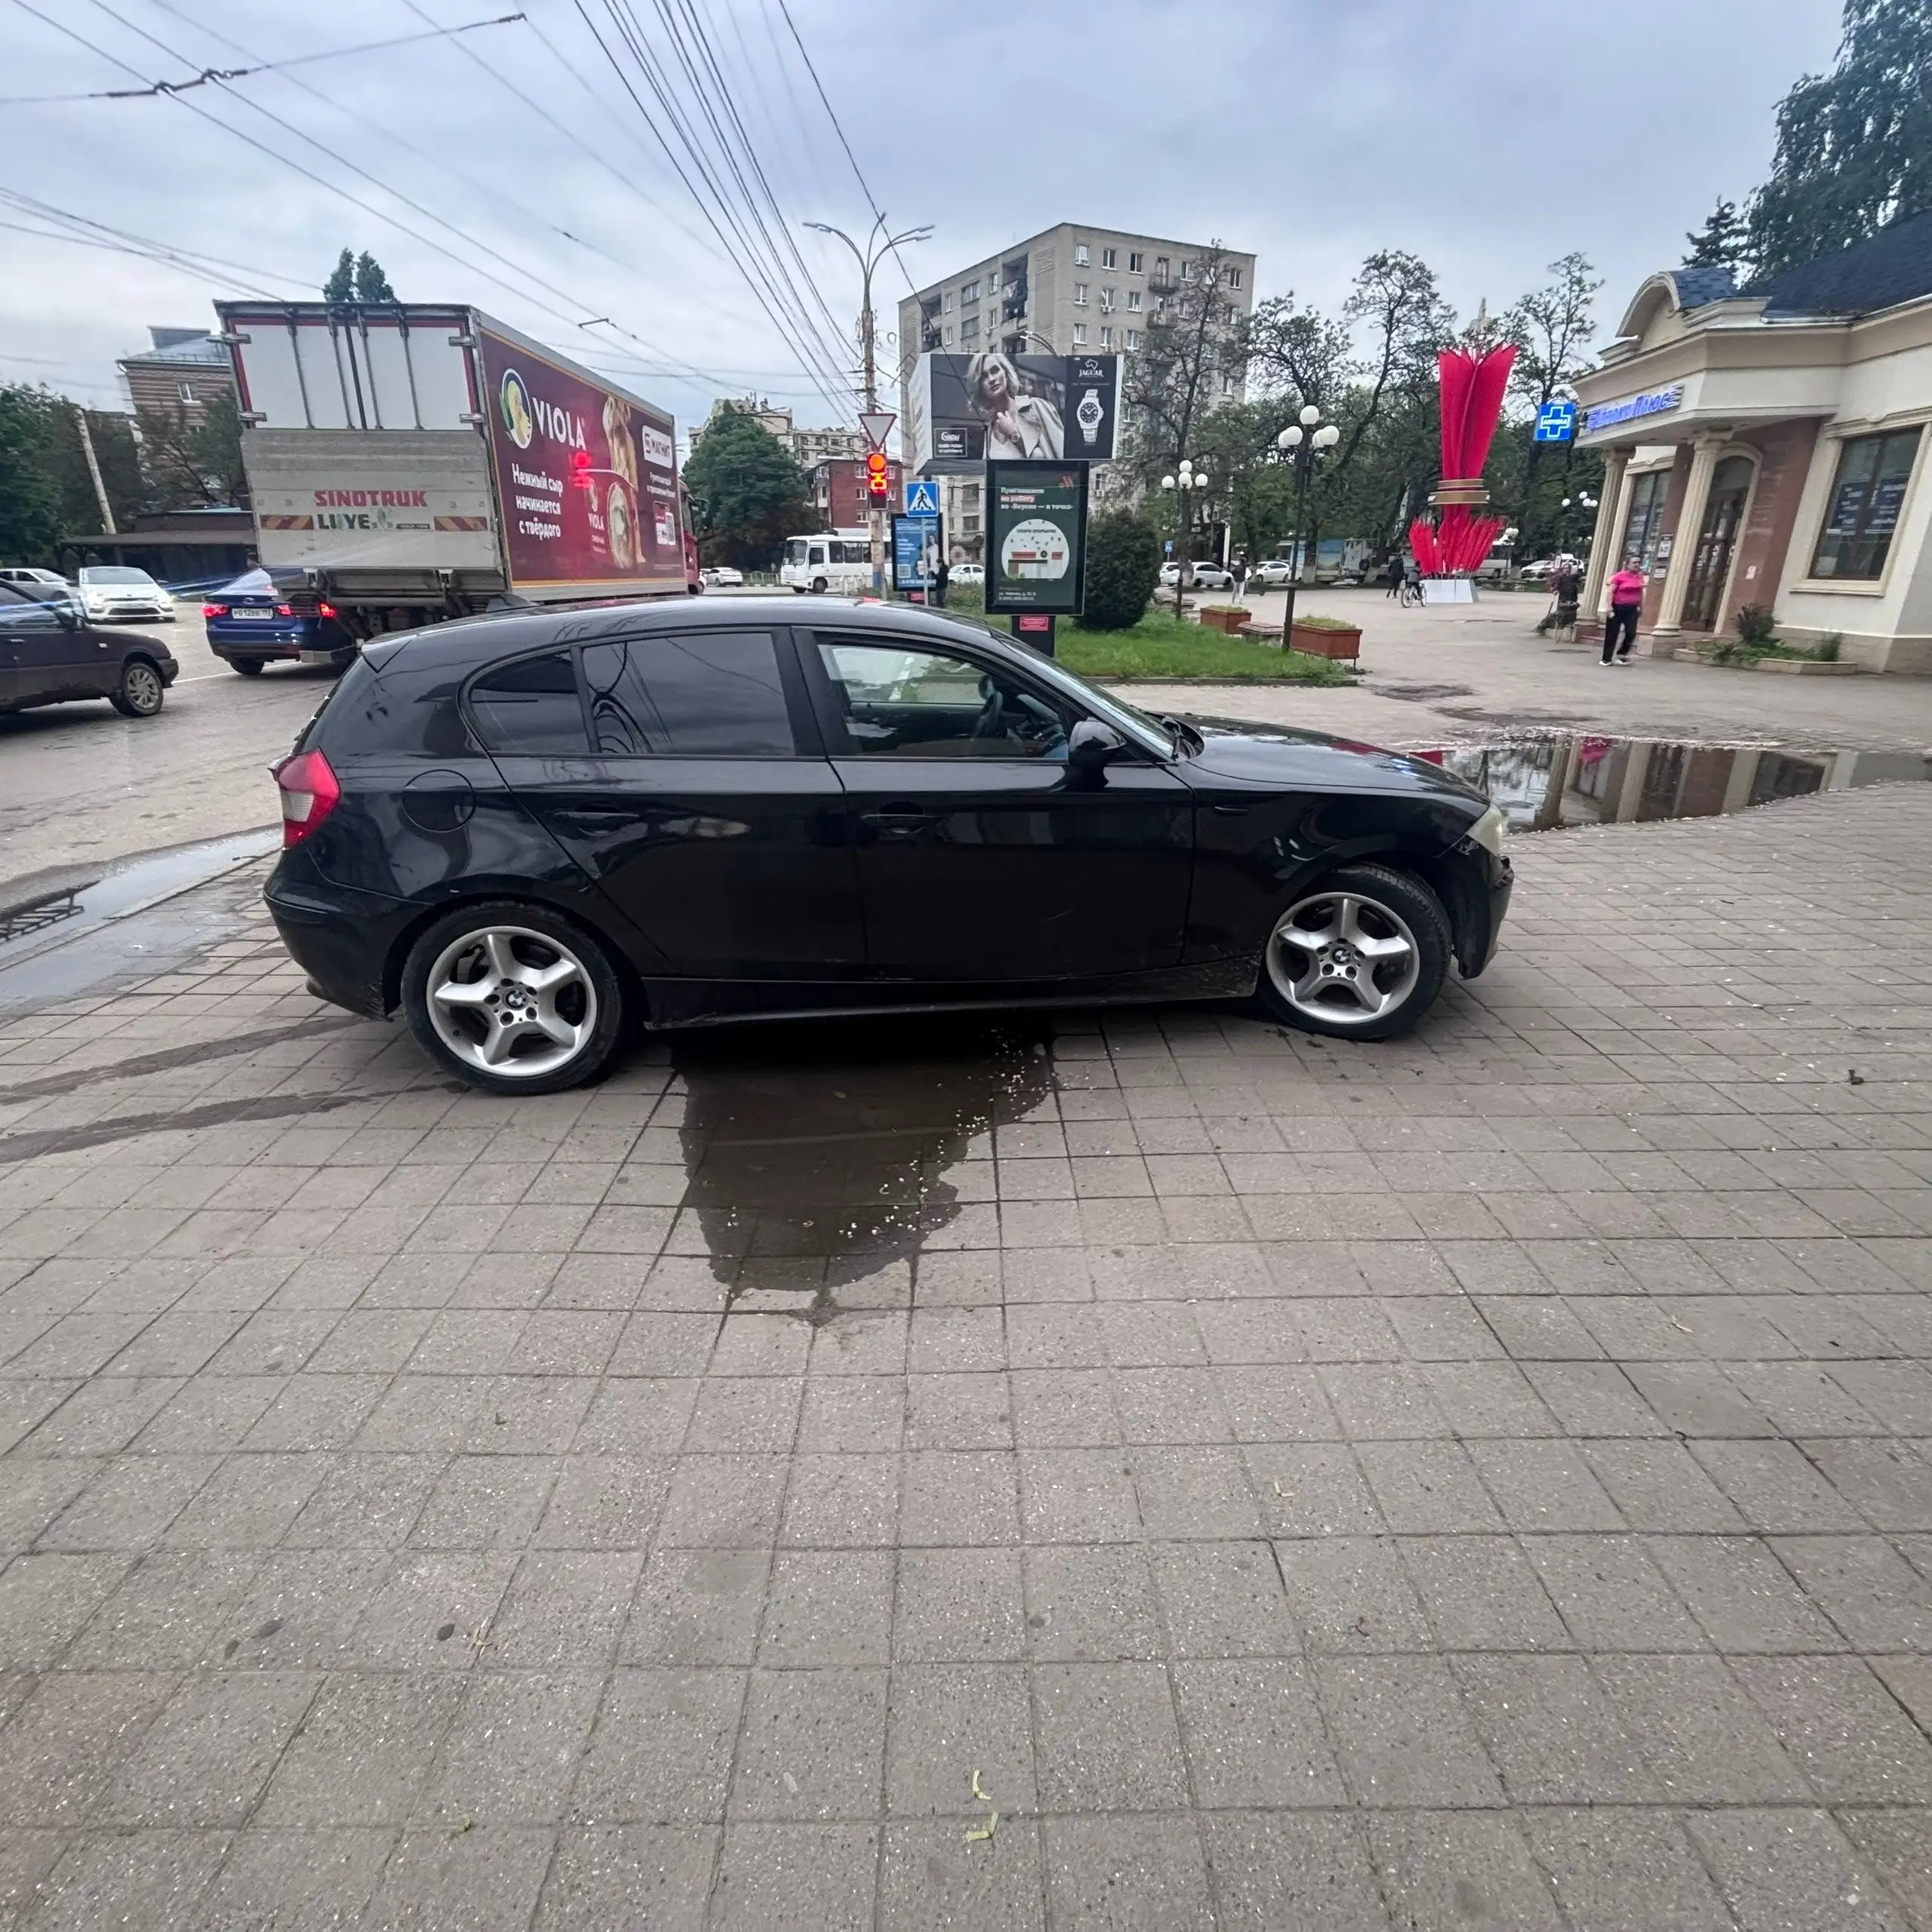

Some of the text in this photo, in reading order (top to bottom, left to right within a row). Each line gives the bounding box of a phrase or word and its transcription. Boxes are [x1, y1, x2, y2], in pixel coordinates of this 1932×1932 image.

[1078, 369, 1104, 377] JAGUAR
[532, 397, 586, 451] VIOLA
[512, 463, 563, 498] Нежный сыр
[314, 491, 429, 507] SINOTRUK
[515, 495, 561, 515] начинается
[518, 517, 561, 540] с твёрдого
